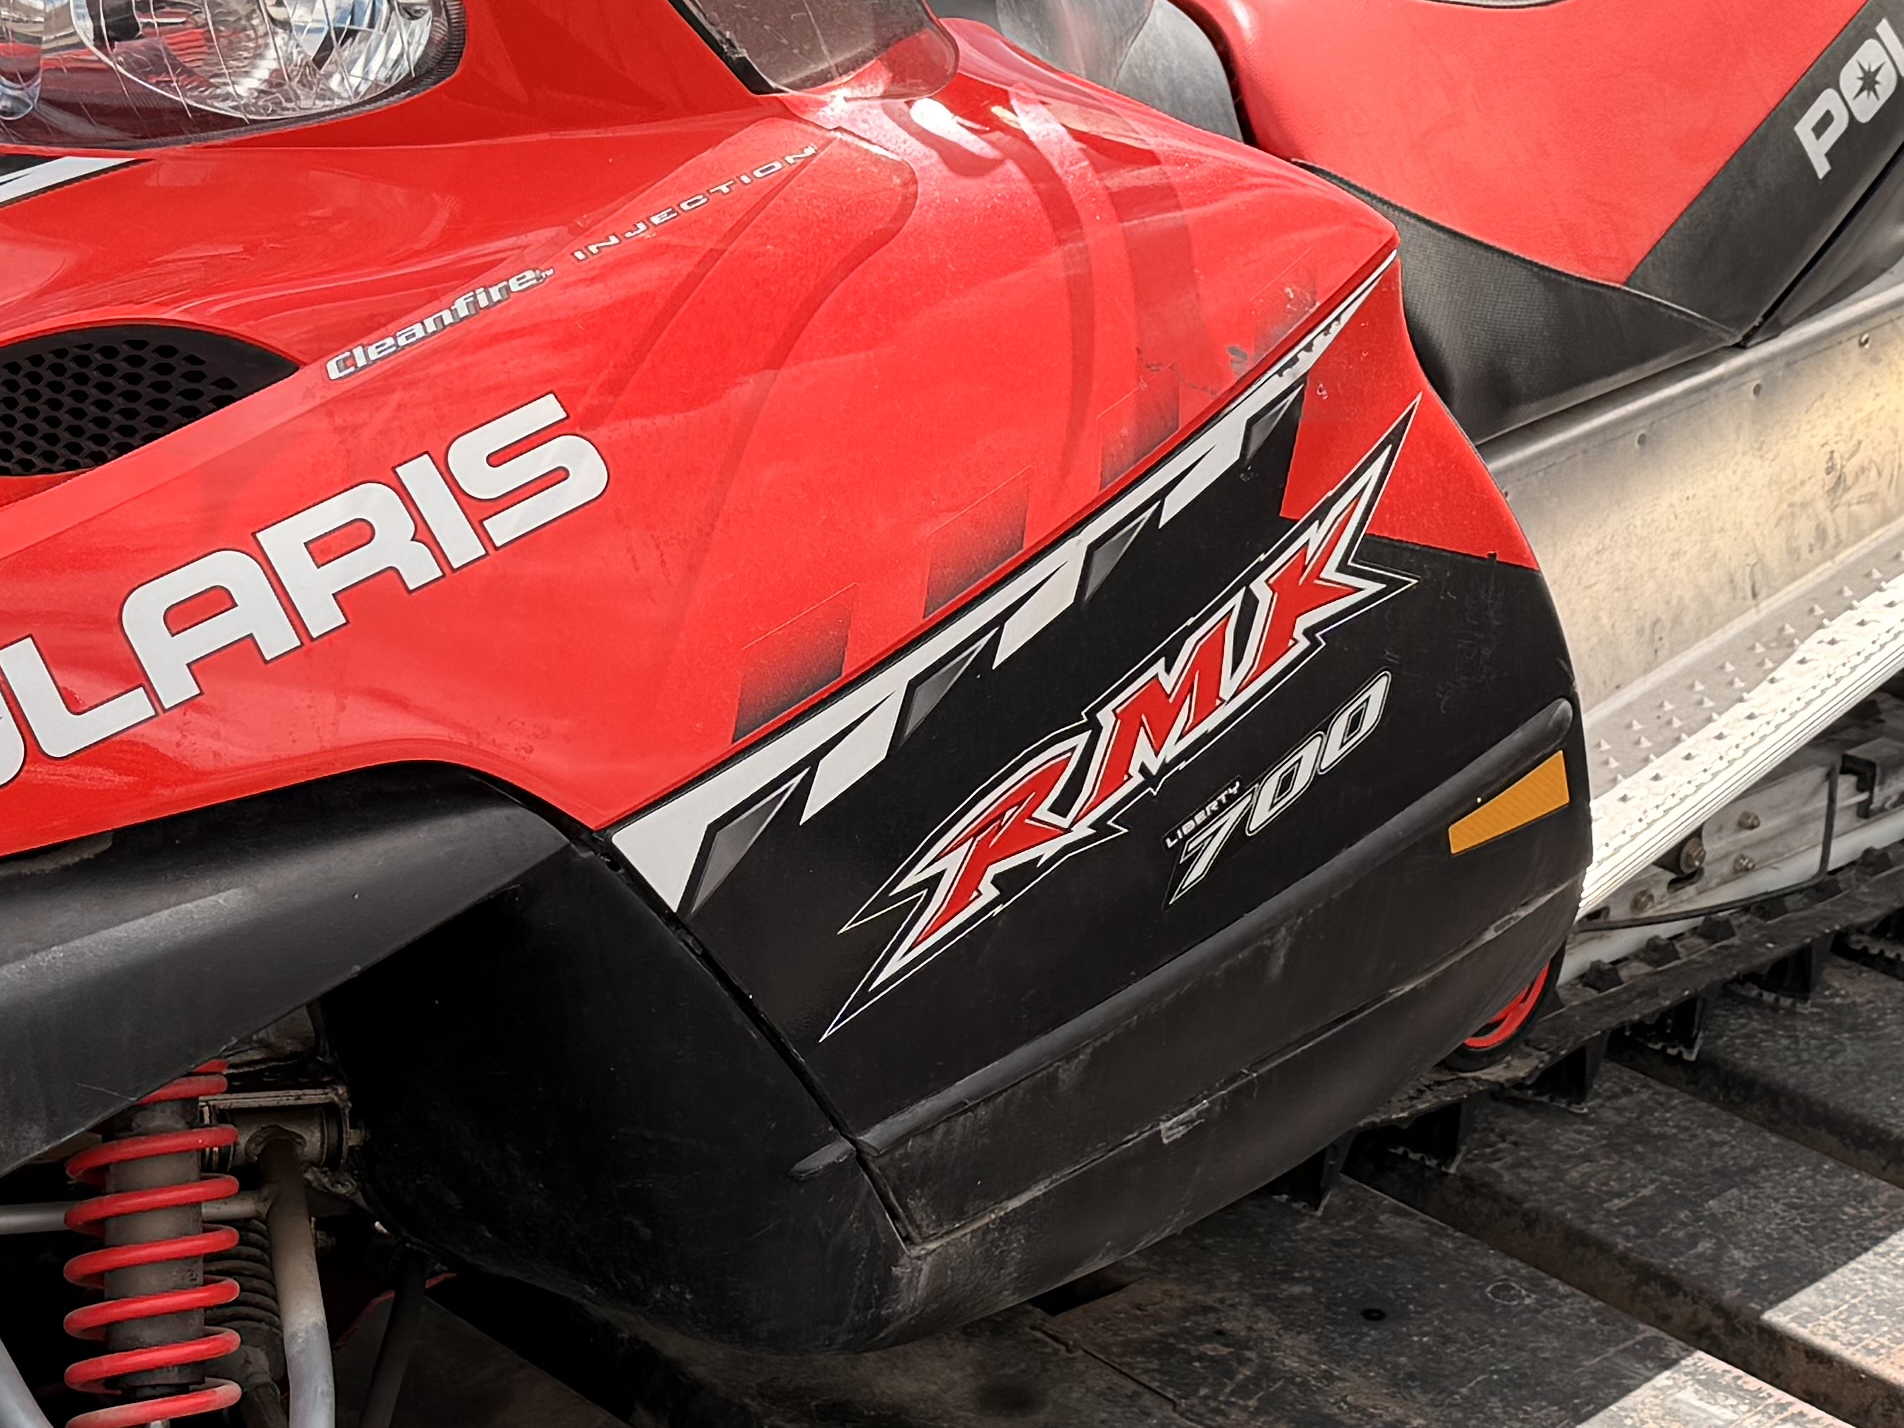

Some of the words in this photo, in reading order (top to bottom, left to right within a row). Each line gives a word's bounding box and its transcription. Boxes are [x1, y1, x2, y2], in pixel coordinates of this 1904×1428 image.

[325, 267, 543, 381] Cleanfire
[571, 144, 820, 262] INJECTION
[844, 420, 1408, 1014] RMK
[1165, 780, 1241, 849] LIBERTY
[1168, 670, 1392, 905] 700
